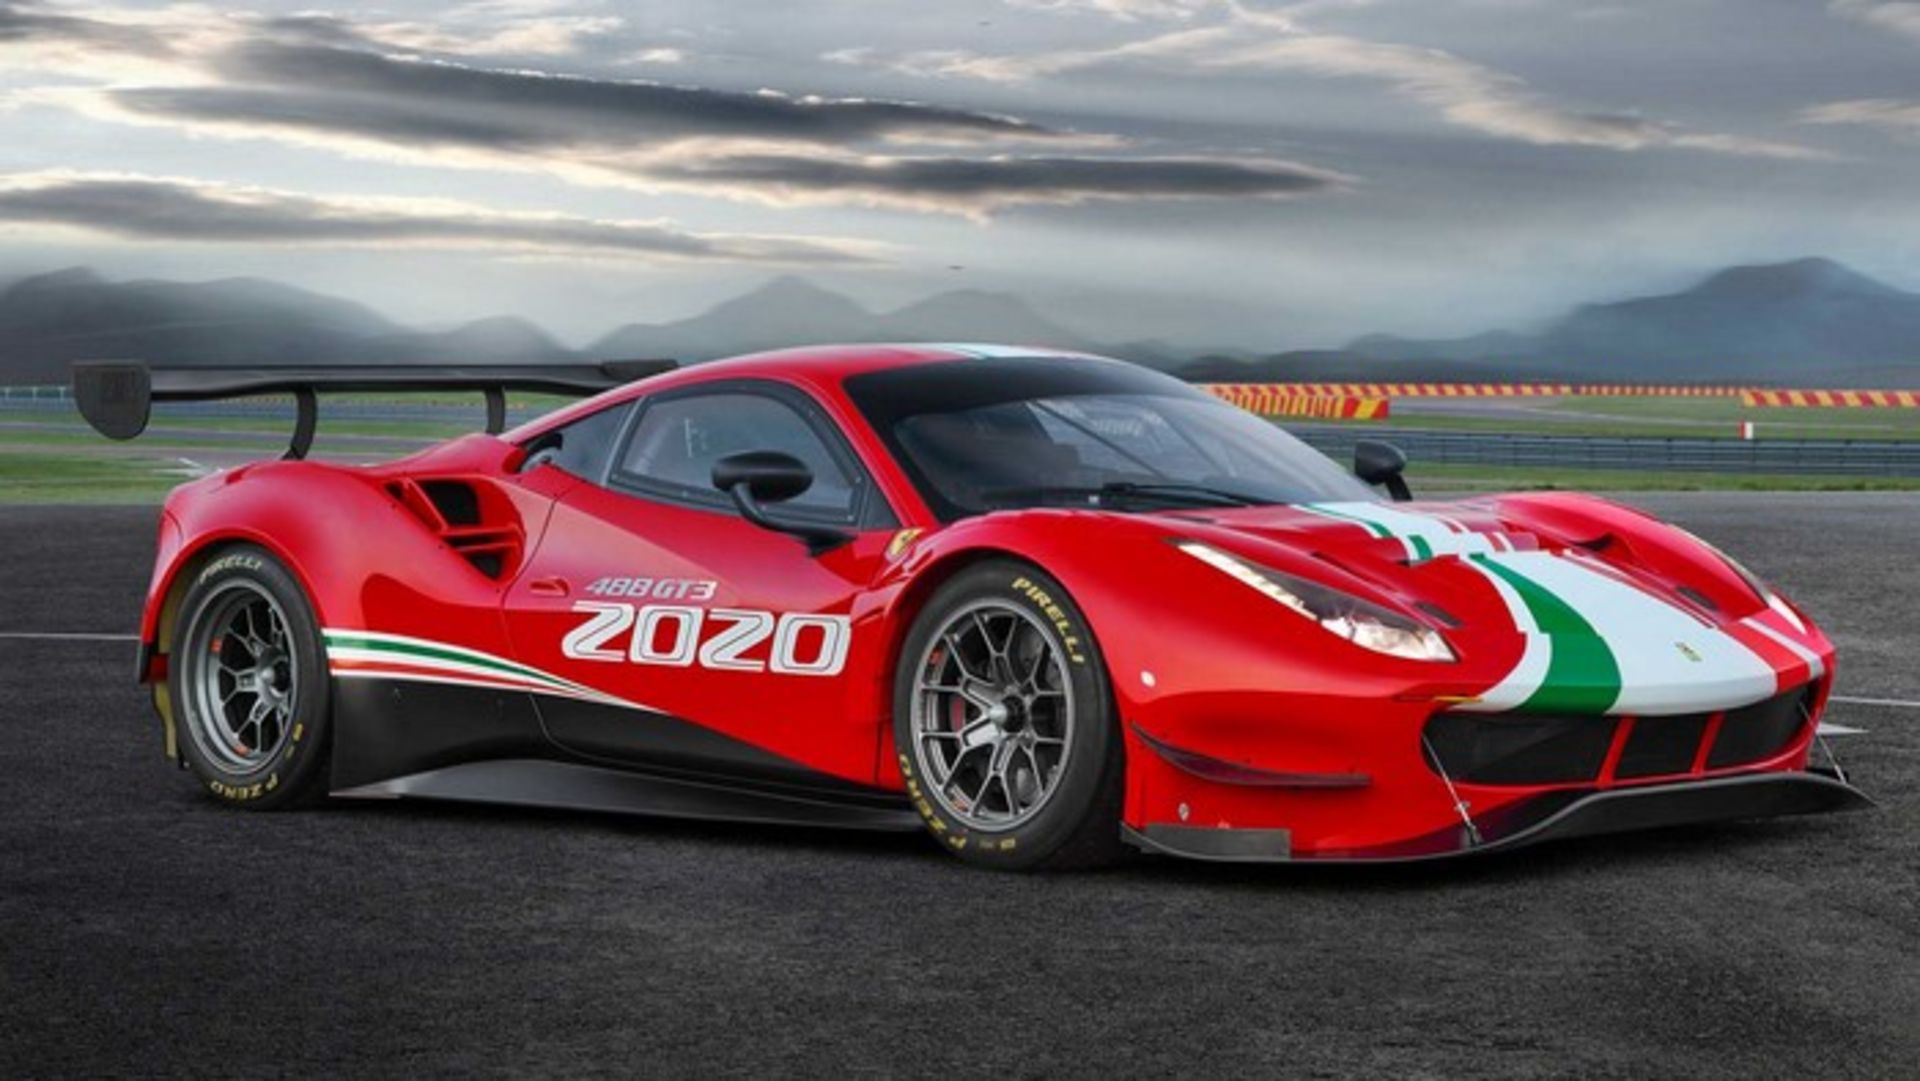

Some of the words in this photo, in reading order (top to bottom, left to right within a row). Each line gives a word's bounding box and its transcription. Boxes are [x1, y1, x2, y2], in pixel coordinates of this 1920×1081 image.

[200, 555, 263, 585] PIRELLI
[585, 577, 652, 597] 488
[652, 580, 718, 600] GT3
[1011, 576, 1085, 664] PIRELLI
[561, 600, 851, 676] 2020
[210, 779, 263, 800] ZERO
